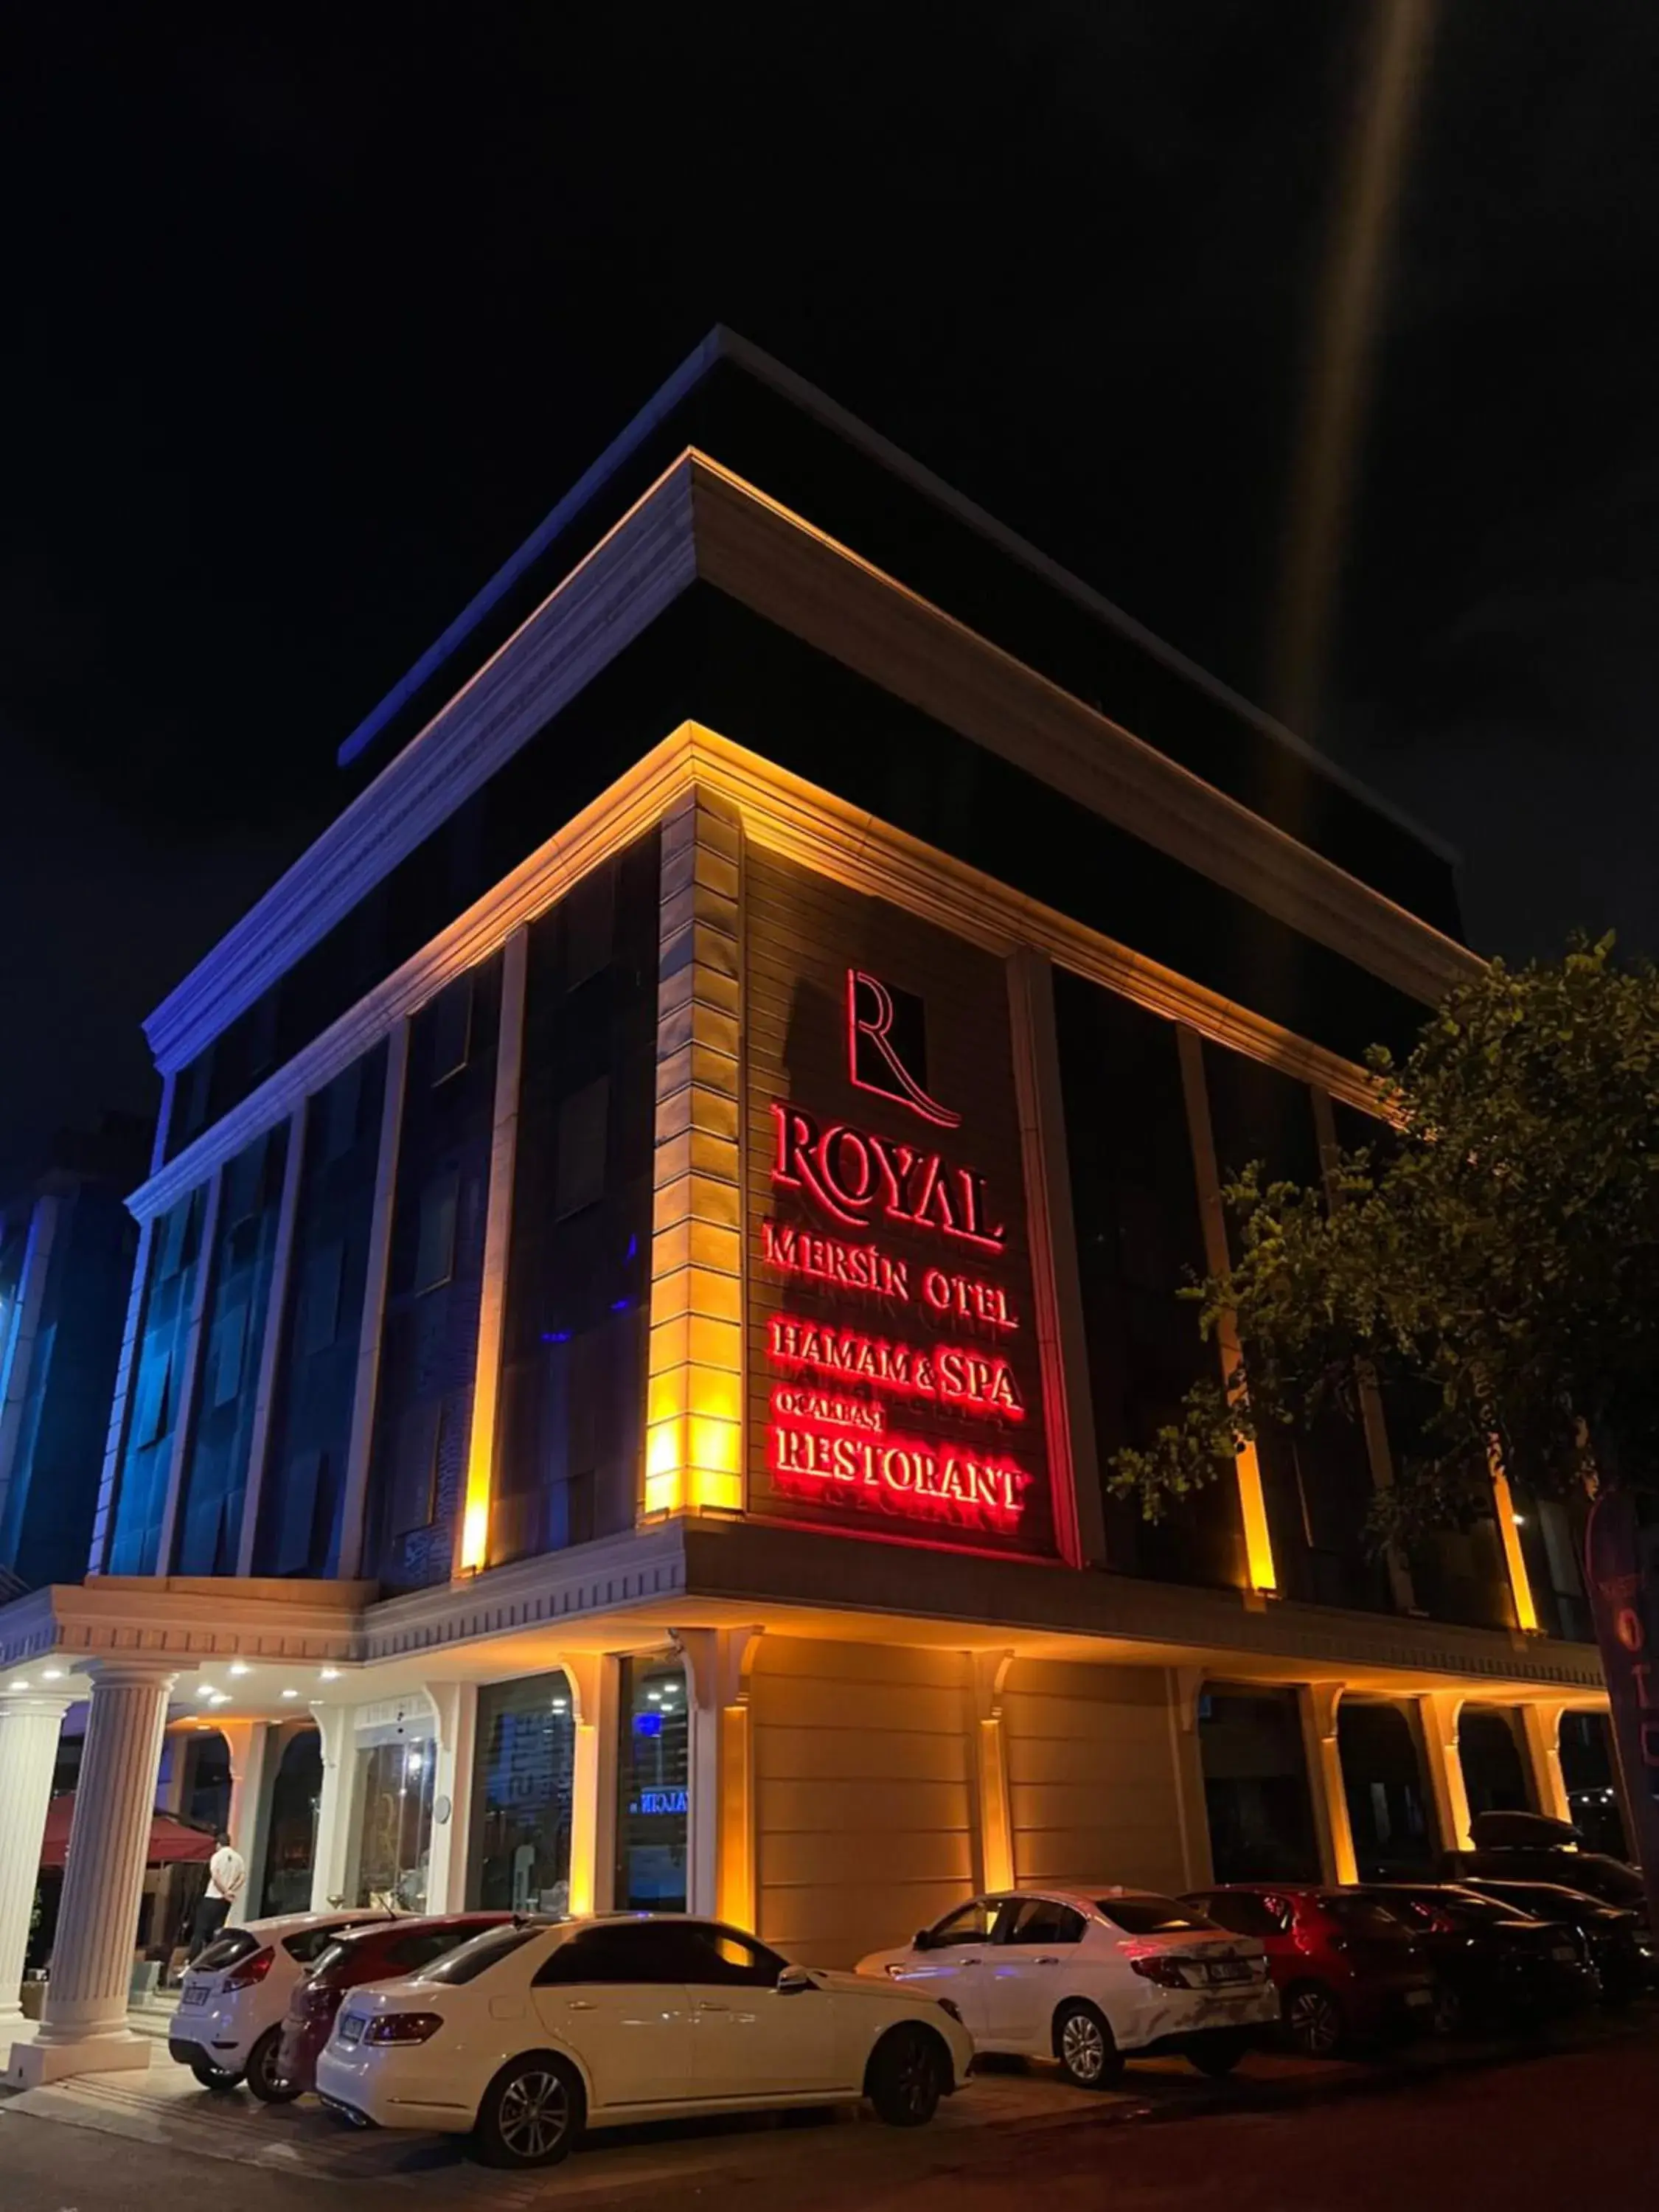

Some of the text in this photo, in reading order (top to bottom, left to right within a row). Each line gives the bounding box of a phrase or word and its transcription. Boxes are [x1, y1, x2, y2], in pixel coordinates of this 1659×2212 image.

[770, 1097, 1008, 1252] ROYAL
[925, 1269, 1019, 1328] OTEL
[771, 1320, 911, 1386] HAMAM
[939, 1352, 1026, 1412] SPA
[775, 1427, 1029, 1511] RESTORANT
